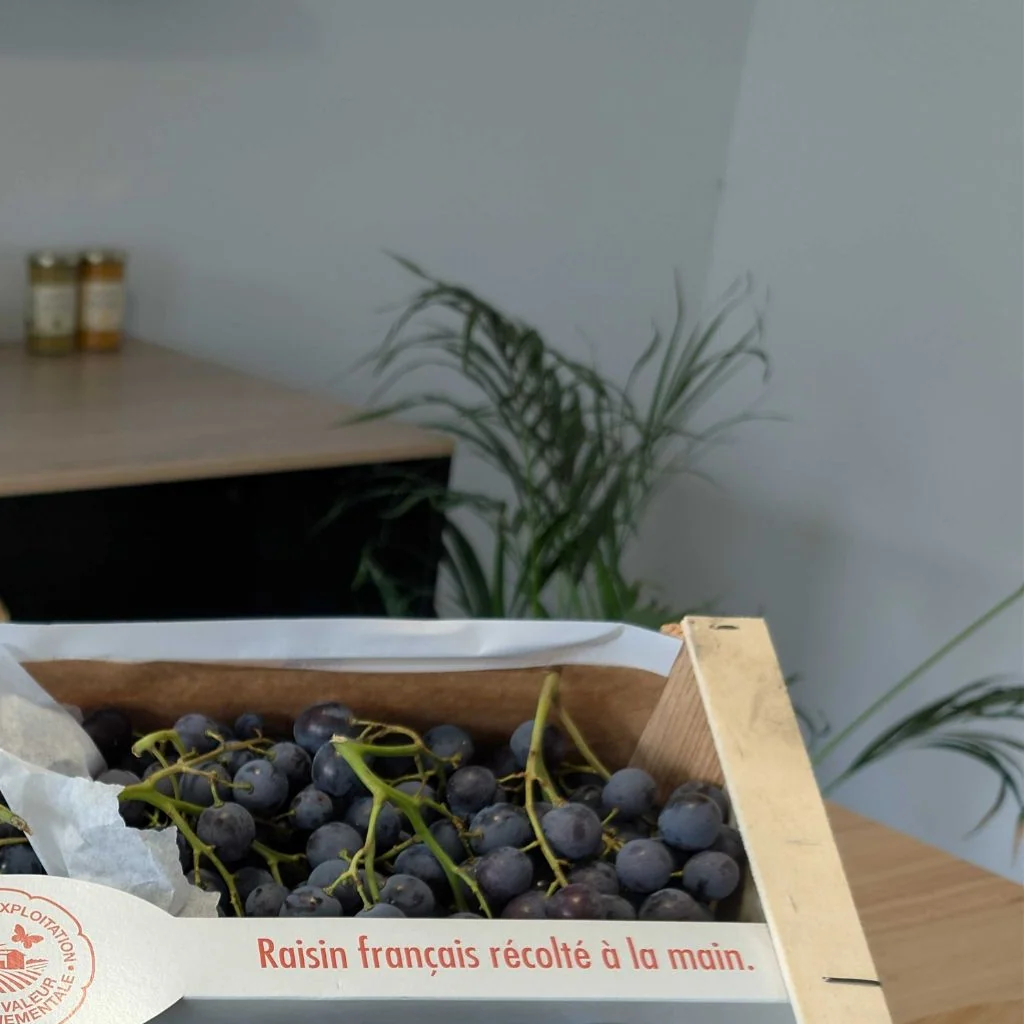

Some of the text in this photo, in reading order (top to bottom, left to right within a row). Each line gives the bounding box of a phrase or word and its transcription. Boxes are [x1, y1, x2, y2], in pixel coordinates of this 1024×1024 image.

[257, 934, 755, 978] Raisin français récolté à la main.
[1, 976, 57, 1013] VALEUR
